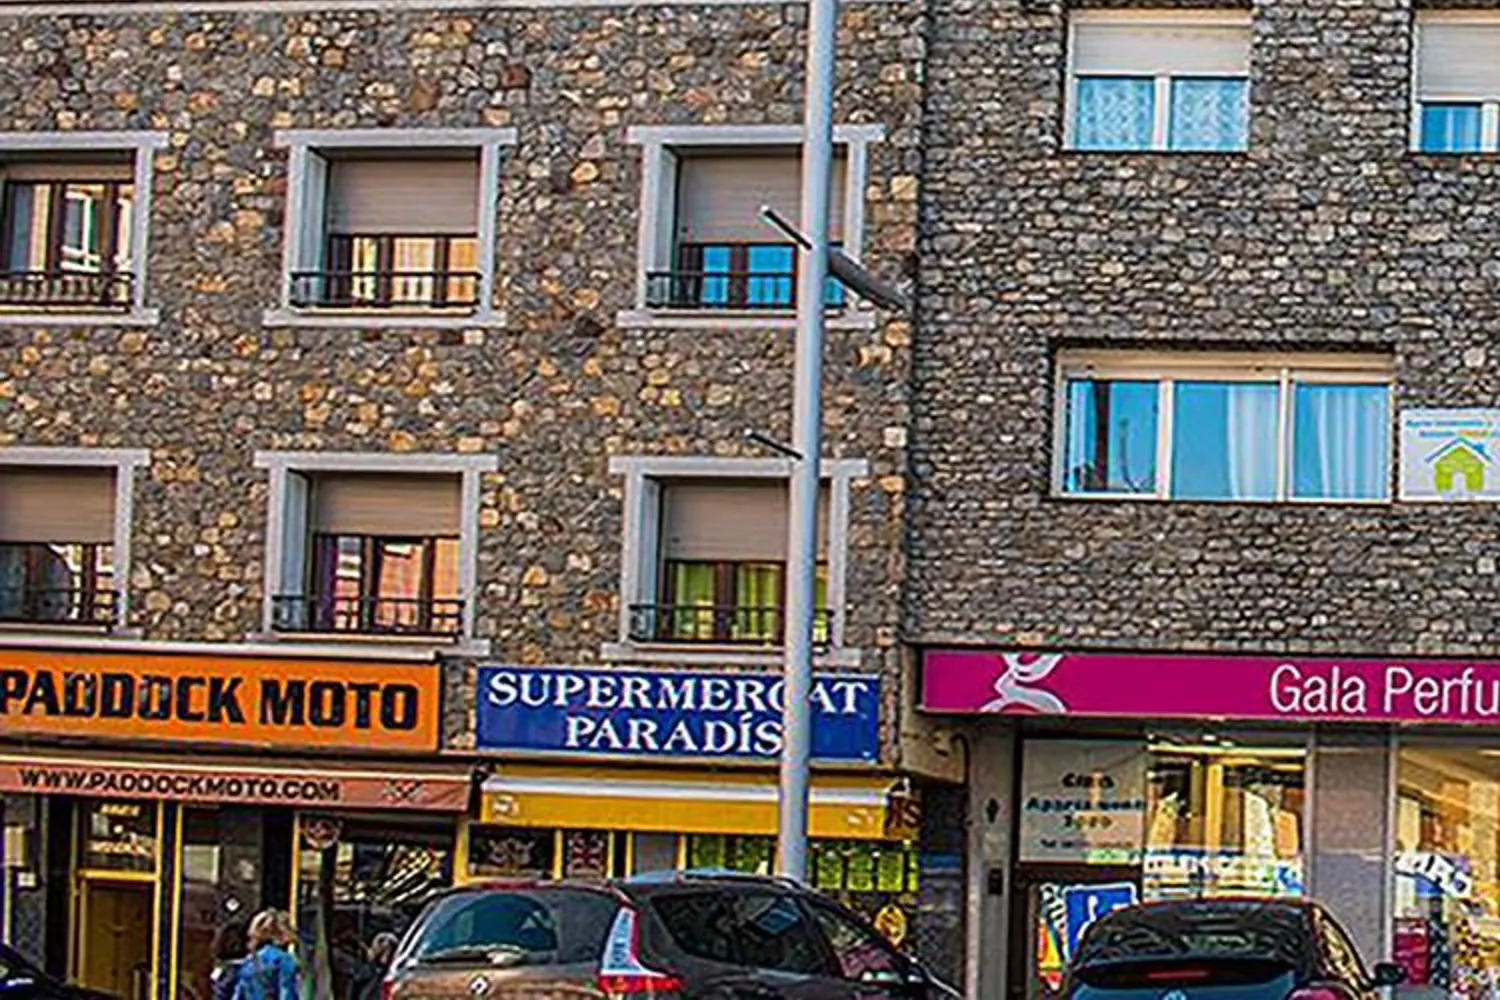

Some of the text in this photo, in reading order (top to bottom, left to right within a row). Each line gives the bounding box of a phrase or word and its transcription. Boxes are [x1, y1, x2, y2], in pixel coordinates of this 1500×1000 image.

[0, 669, 420, 732] PADDOCK MOTO
[1270, 664, 1366, 713] Gala
[565, 712, 784, 755] PARADÍS
[18, 767, 341, 802] WWW.PADDOCKMOTO.COM
